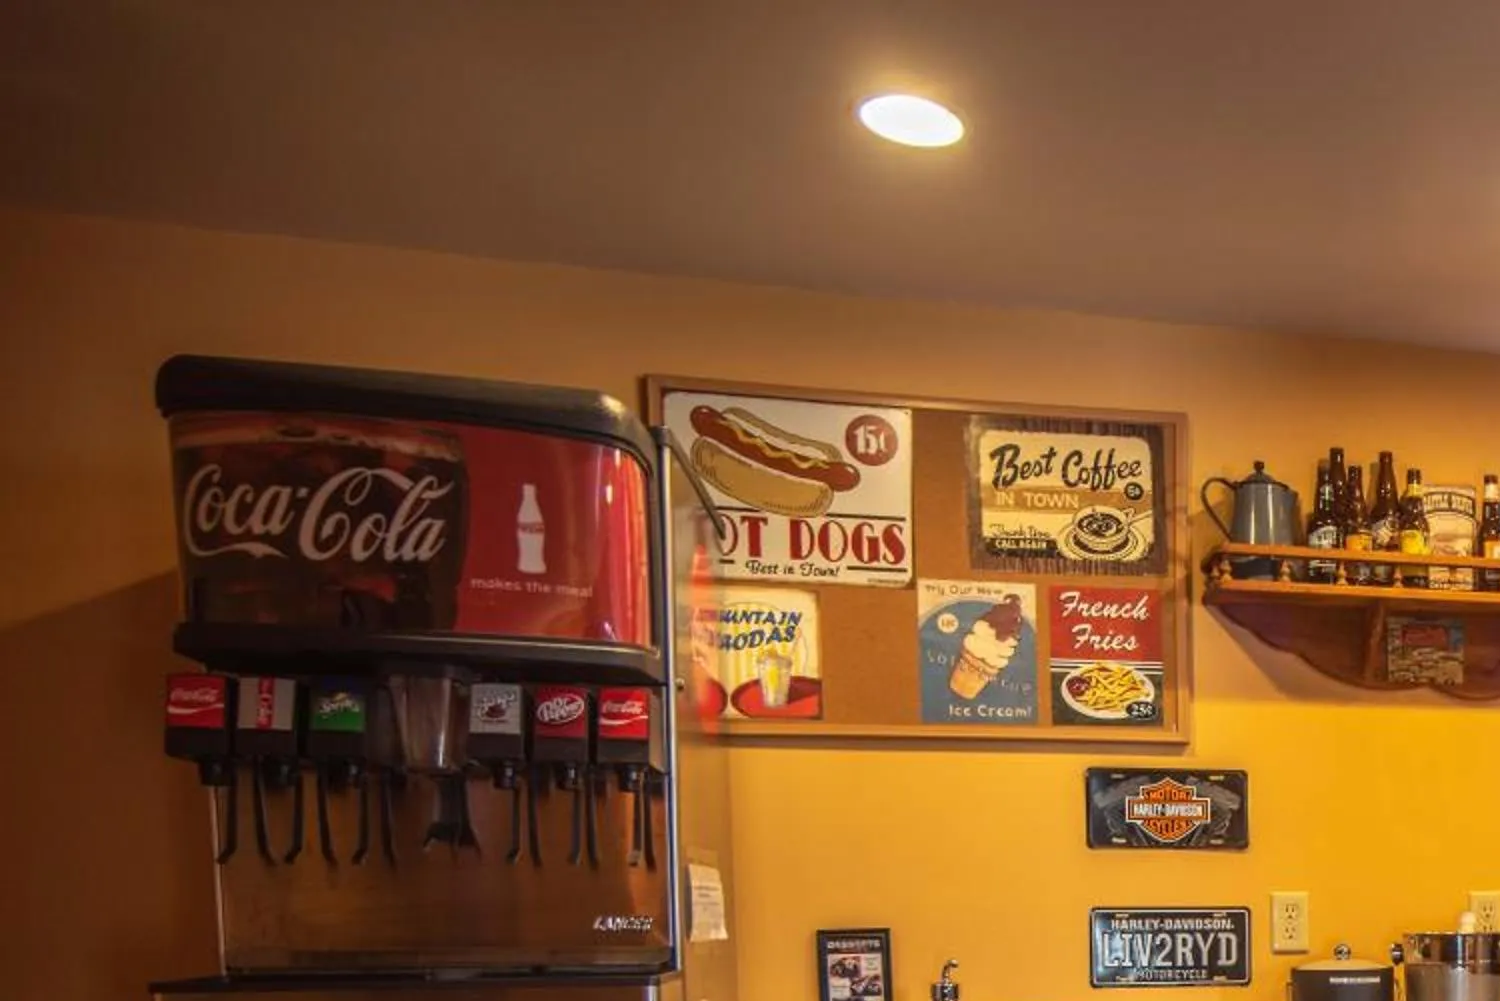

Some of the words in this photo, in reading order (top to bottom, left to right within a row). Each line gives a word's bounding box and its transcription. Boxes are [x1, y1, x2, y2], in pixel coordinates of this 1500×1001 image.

[989, 443, 1057, 490] Best
[1061, 448, 1142, 491] Coffee
[184, 464, 455, 563] Coca-Cola
[995, 491, 1014, 506] IN
[1023, 491, 1080, 509] TOWN
[714, 512, 769, 558] OT
[789, 519, 906, 565] DOGS
[745, 560, 779, 576] Best
[783, 562, 795, 576] in
[800, 560, 840, 578] Town!
[717, 608, 802, 627] UNTAIN
[1059, 591, 1150, 622] French
[1071, 624, 1139, 651] Fries
[949, 704, 971, 717] Ice
[977, 704, 1032, 718] Cream!
